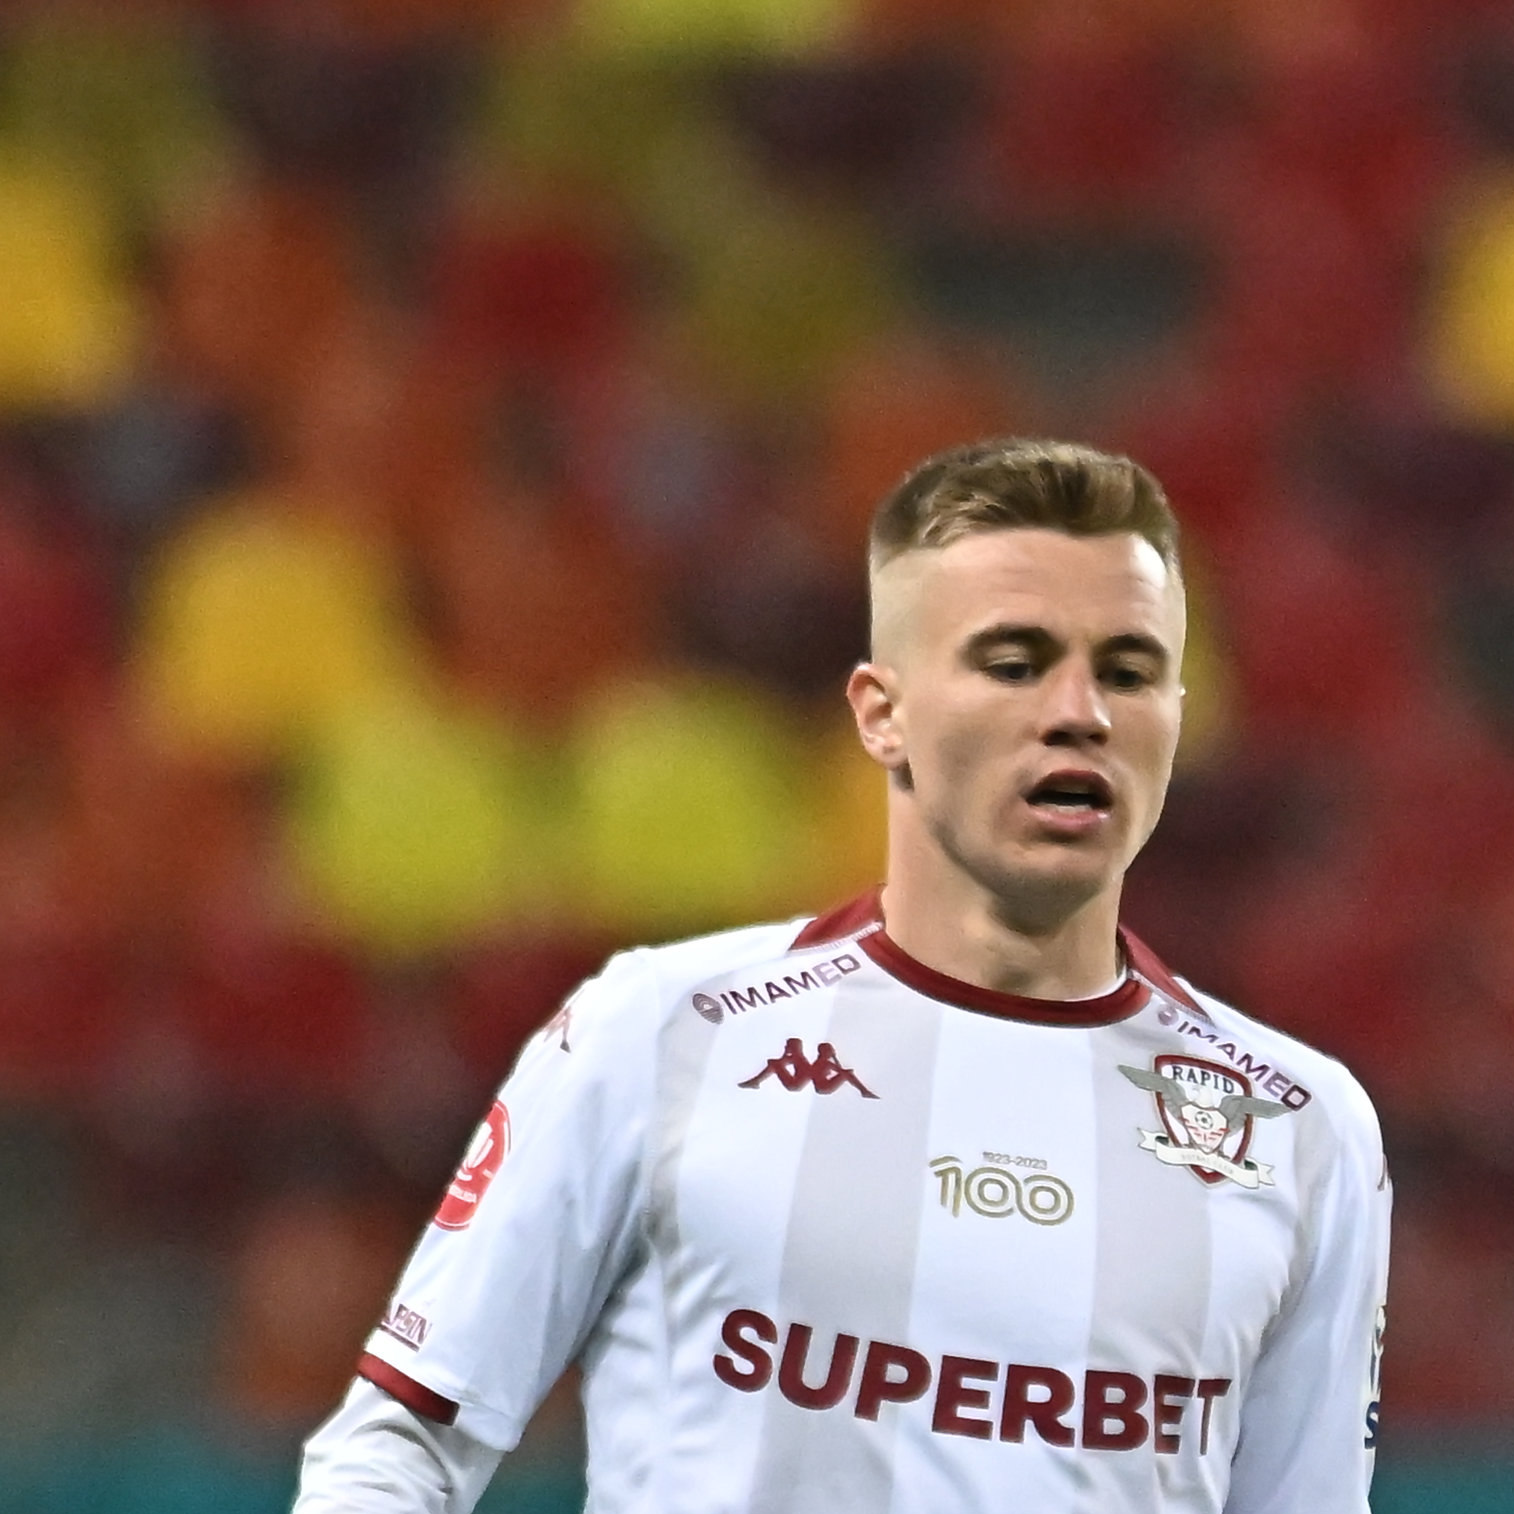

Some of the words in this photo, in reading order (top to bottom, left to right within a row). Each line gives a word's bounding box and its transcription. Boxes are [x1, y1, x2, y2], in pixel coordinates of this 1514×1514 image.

[719, 953, 862, 1015] IMAMED
[1171, 1064, 1236, 1095] RAPID
[1177, 1020, 1313, 1112] IMAMED
[928, 1155, 1075, 1226] 100
[713, 1308, 1232, 1456] SUPERBET
